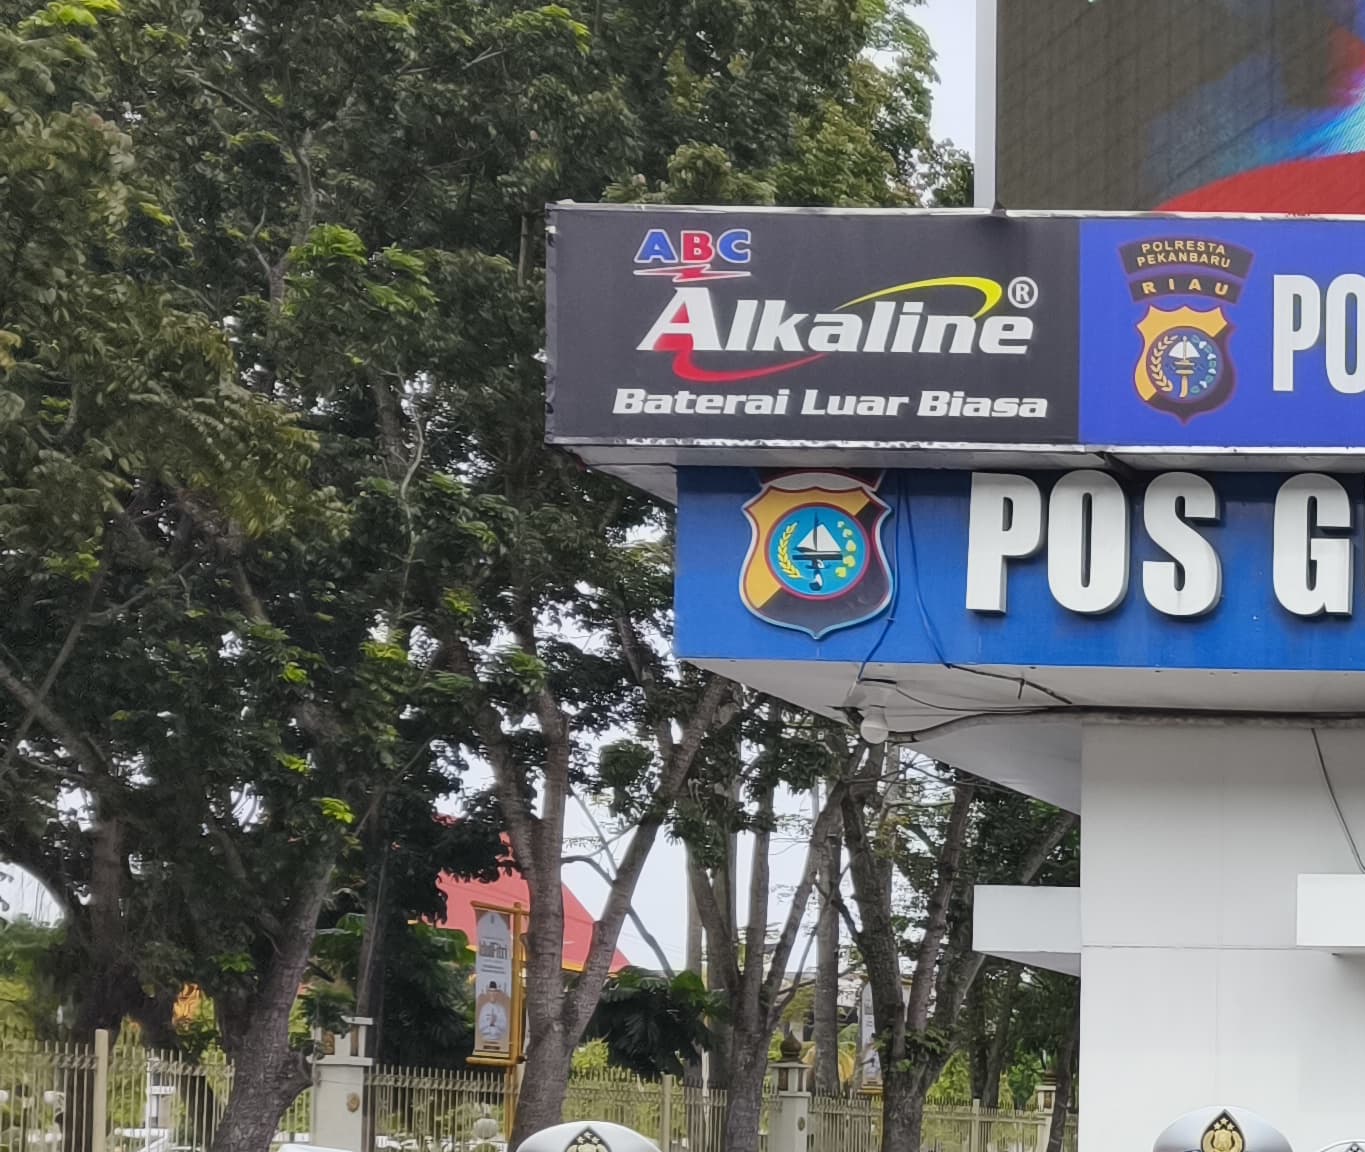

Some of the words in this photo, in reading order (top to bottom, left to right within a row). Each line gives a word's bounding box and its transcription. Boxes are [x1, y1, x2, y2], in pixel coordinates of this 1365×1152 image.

[634, 228, 752, 264] ABC
[1136, 252, 1231, 268] PEKANBARU
[1141, 240, 1226, 255] POLRESTA
[636, 287, 1035, 356] Alkaline
[612, 389, 788, 416] Baterai
[800, 389, 909, 417] Luar
[917, 390, 1048, 418] Biasa
[965, 469, 1222, 619] POS
